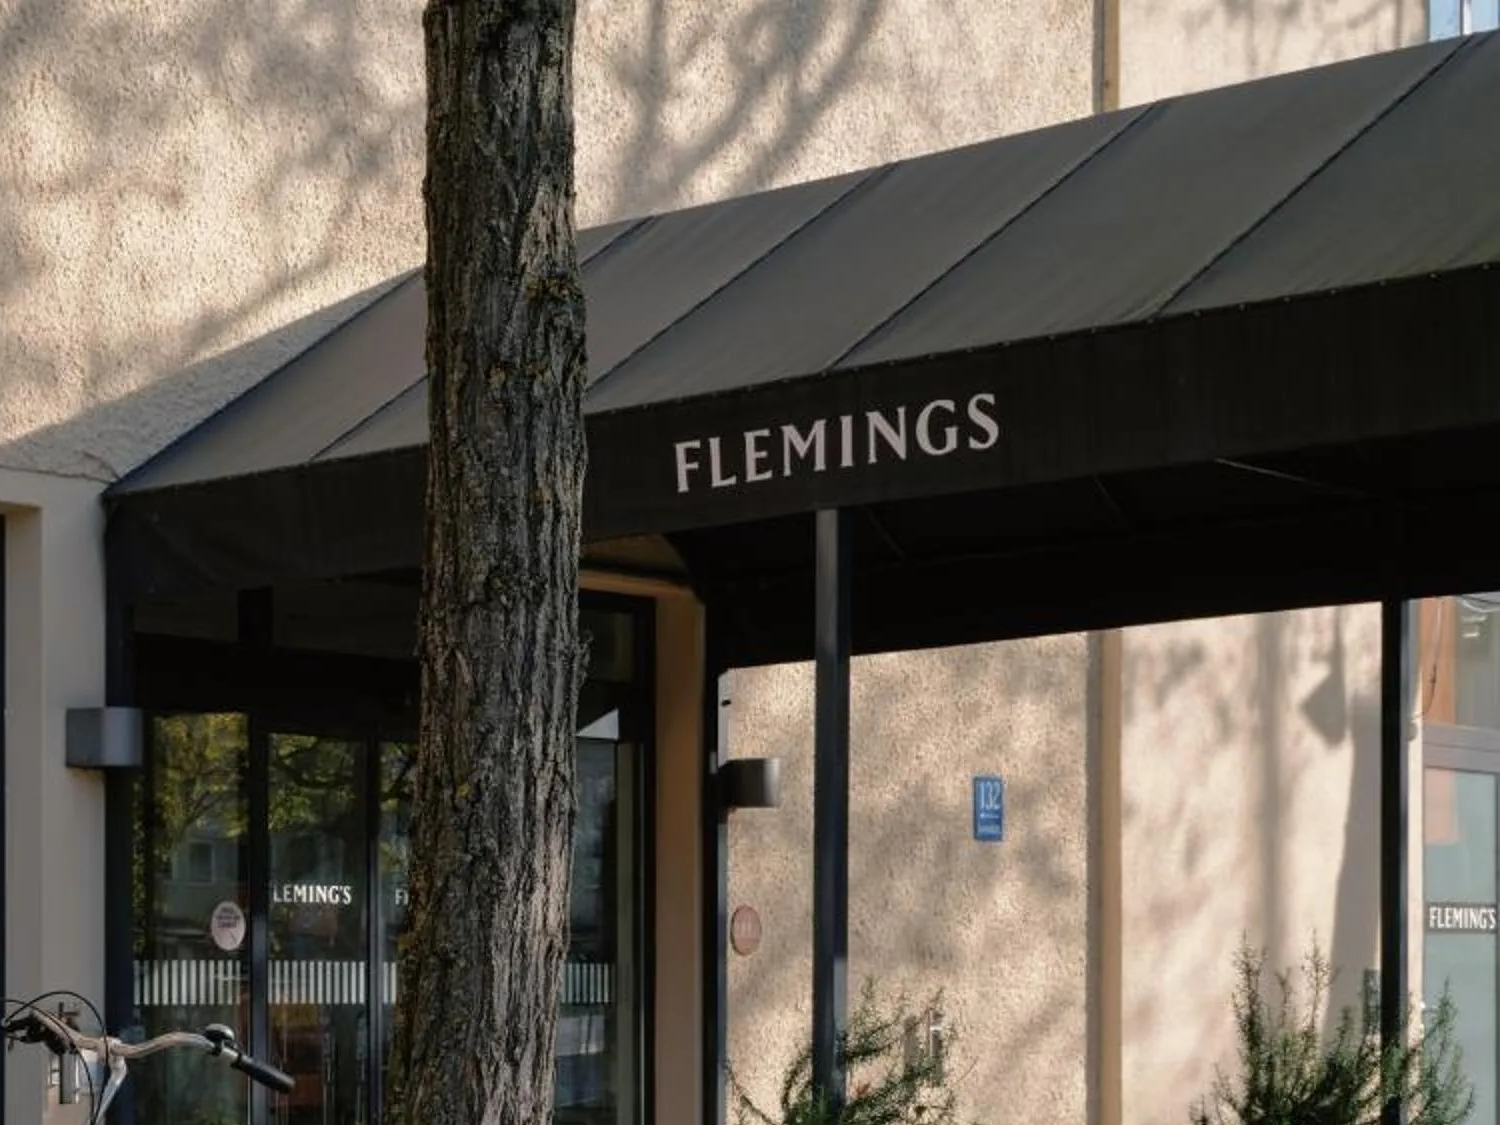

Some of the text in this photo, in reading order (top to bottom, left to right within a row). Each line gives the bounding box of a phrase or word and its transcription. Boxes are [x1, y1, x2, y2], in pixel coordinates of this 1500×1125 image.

[674, 392, 1000, 494] FLEMINGS
[979, 781, 1001, 811] 132
[273, 884, 353, 905] LEMING'S
